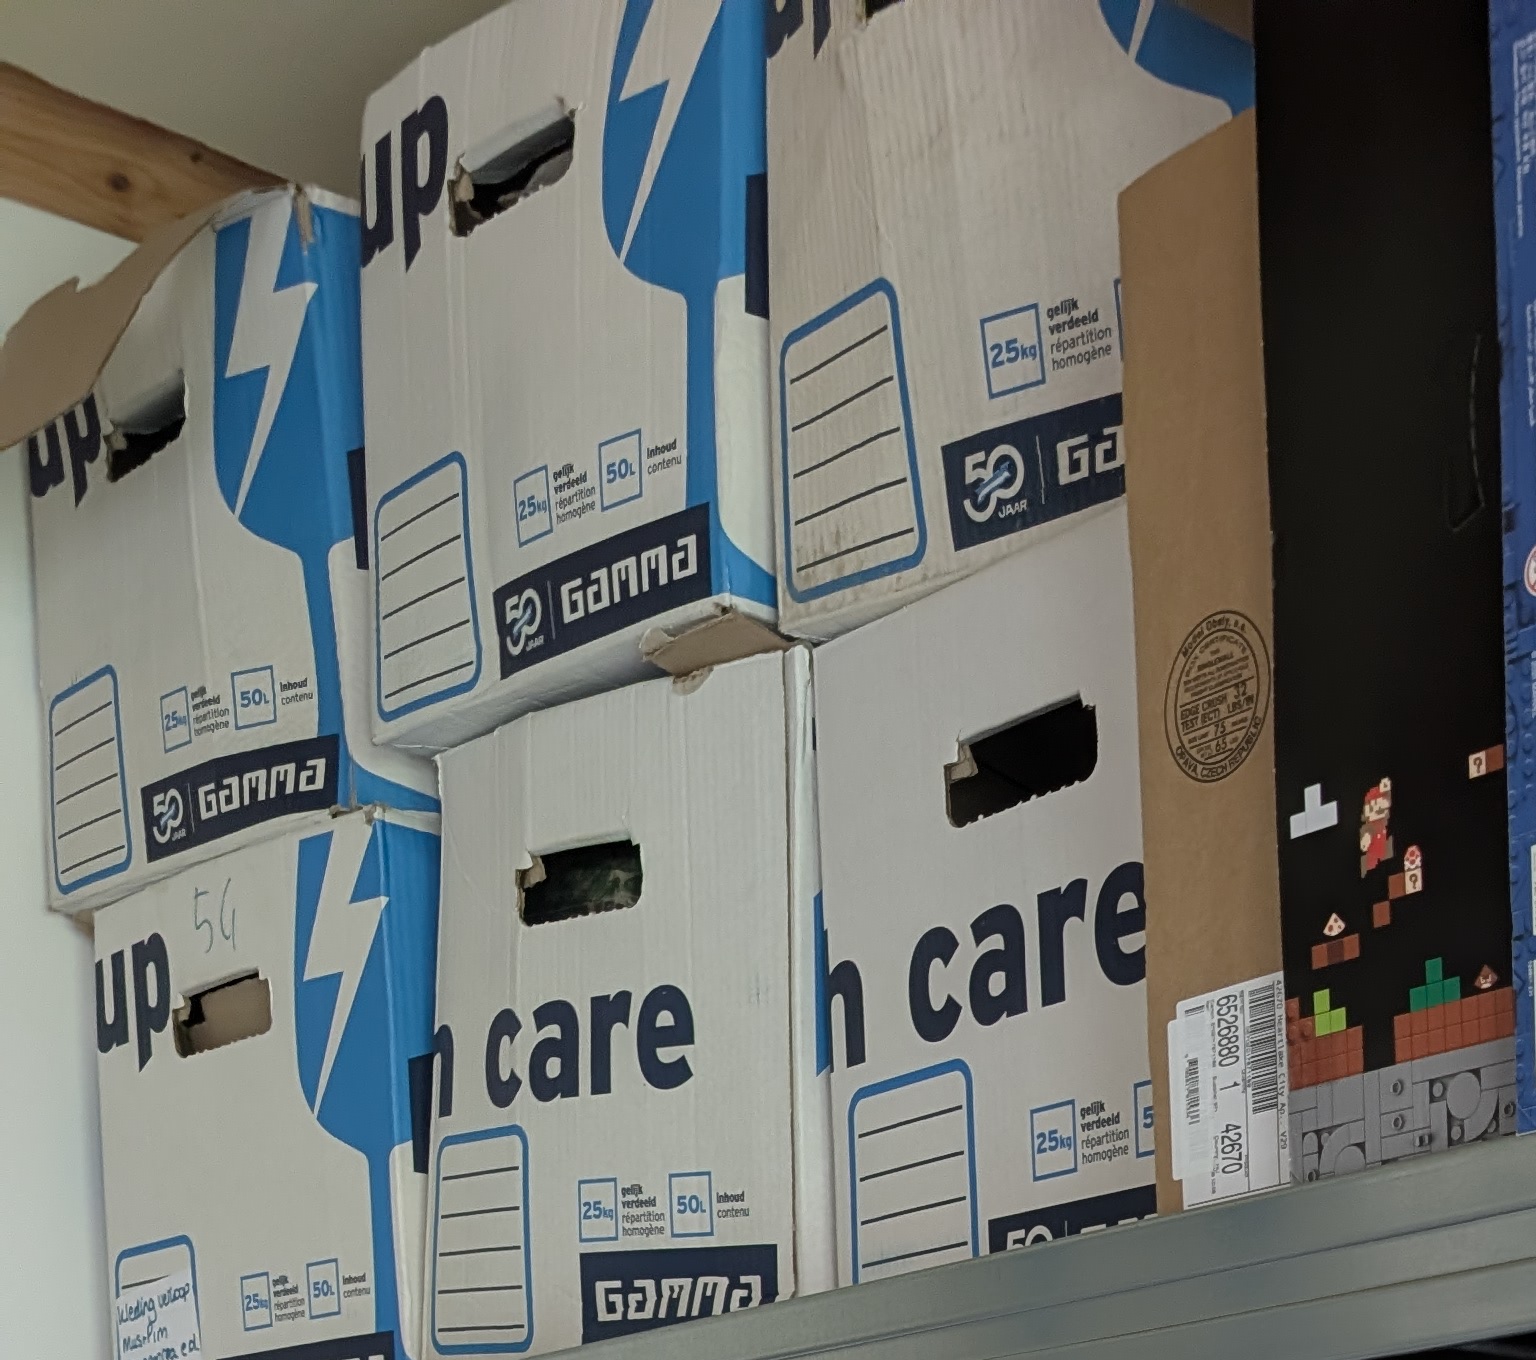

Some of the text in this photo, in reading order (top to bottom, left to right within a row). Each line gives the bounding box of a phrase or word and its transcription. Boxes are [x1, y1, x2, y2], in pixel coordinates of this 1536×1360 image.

[1047, 298, 1079, 319] gelijk
[1049, 308, 1099, 335] verdeeld
[990, 338, 1037, 369] 25kg
[648, 455, 681, 475] contenu
[907, 861, 1147, 1043] care
[95, 931, 171, 1072] up
[485, 984, 695, 1111] care
[1216, 994, 1243, 1175] 6526880 42670
[1080, 1100, 1105, 1119] gelijk
[1081, 1112, 1120, 1132] verdeeld
[1036, 1129, 1072, 1154] 25kg
[583, 1201, 613, 1221] 25kg
[717, 1207, 749, 1218] contenu
